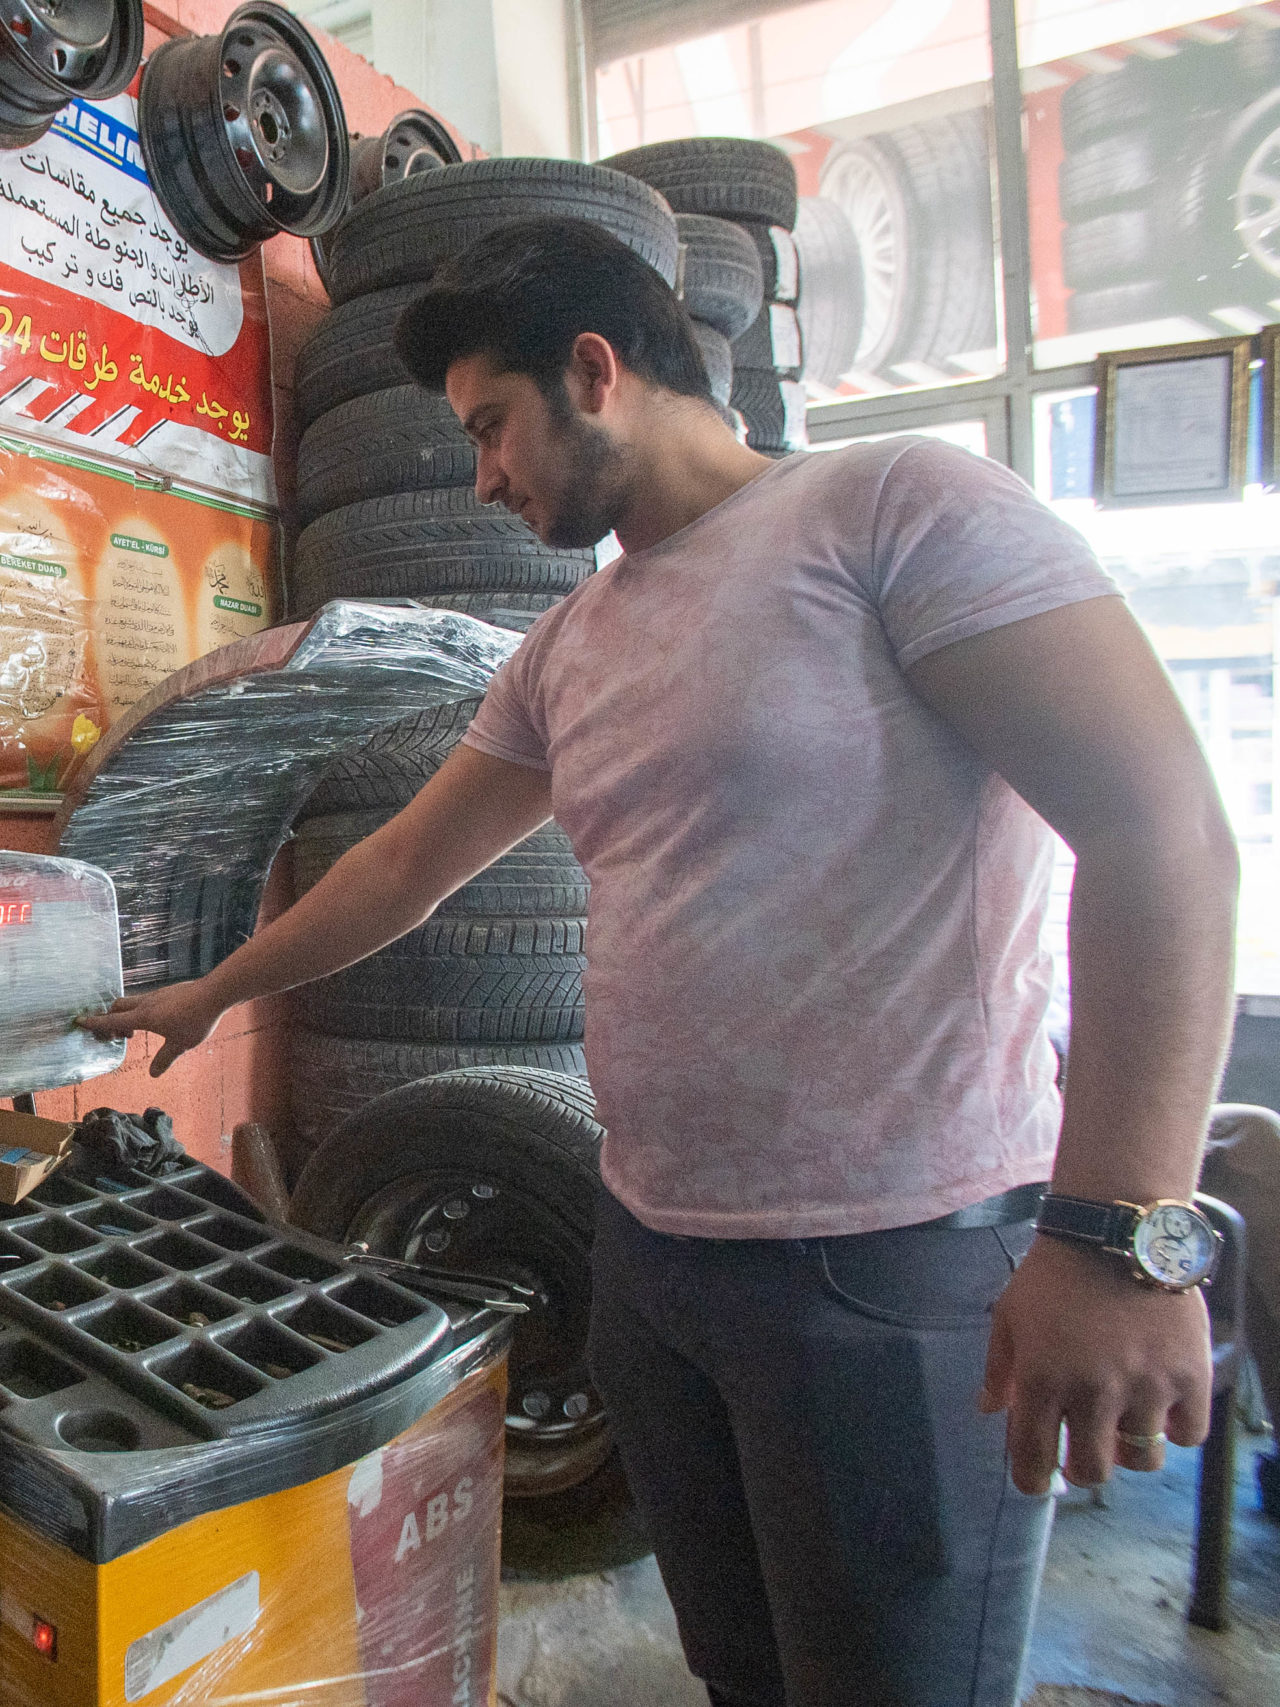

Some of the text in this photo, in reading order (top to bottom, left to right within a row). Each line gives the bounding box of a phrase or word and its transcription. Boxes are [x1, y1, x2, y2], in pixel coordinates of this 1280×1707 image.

[54, 102, 147, 174] HELIN
[20, 154, 188, 264] يوجد جميع مقاسات
[39, 330, 119, 391] طرقات
[128, 353, 191, 404] خدمة
[195, 391, 251, 442] يوجد
[0, 555, 37, 571] BEREKET
[220, 598, 239, 609] NAZAR
[393, 1475, 474, 1564] ABS
